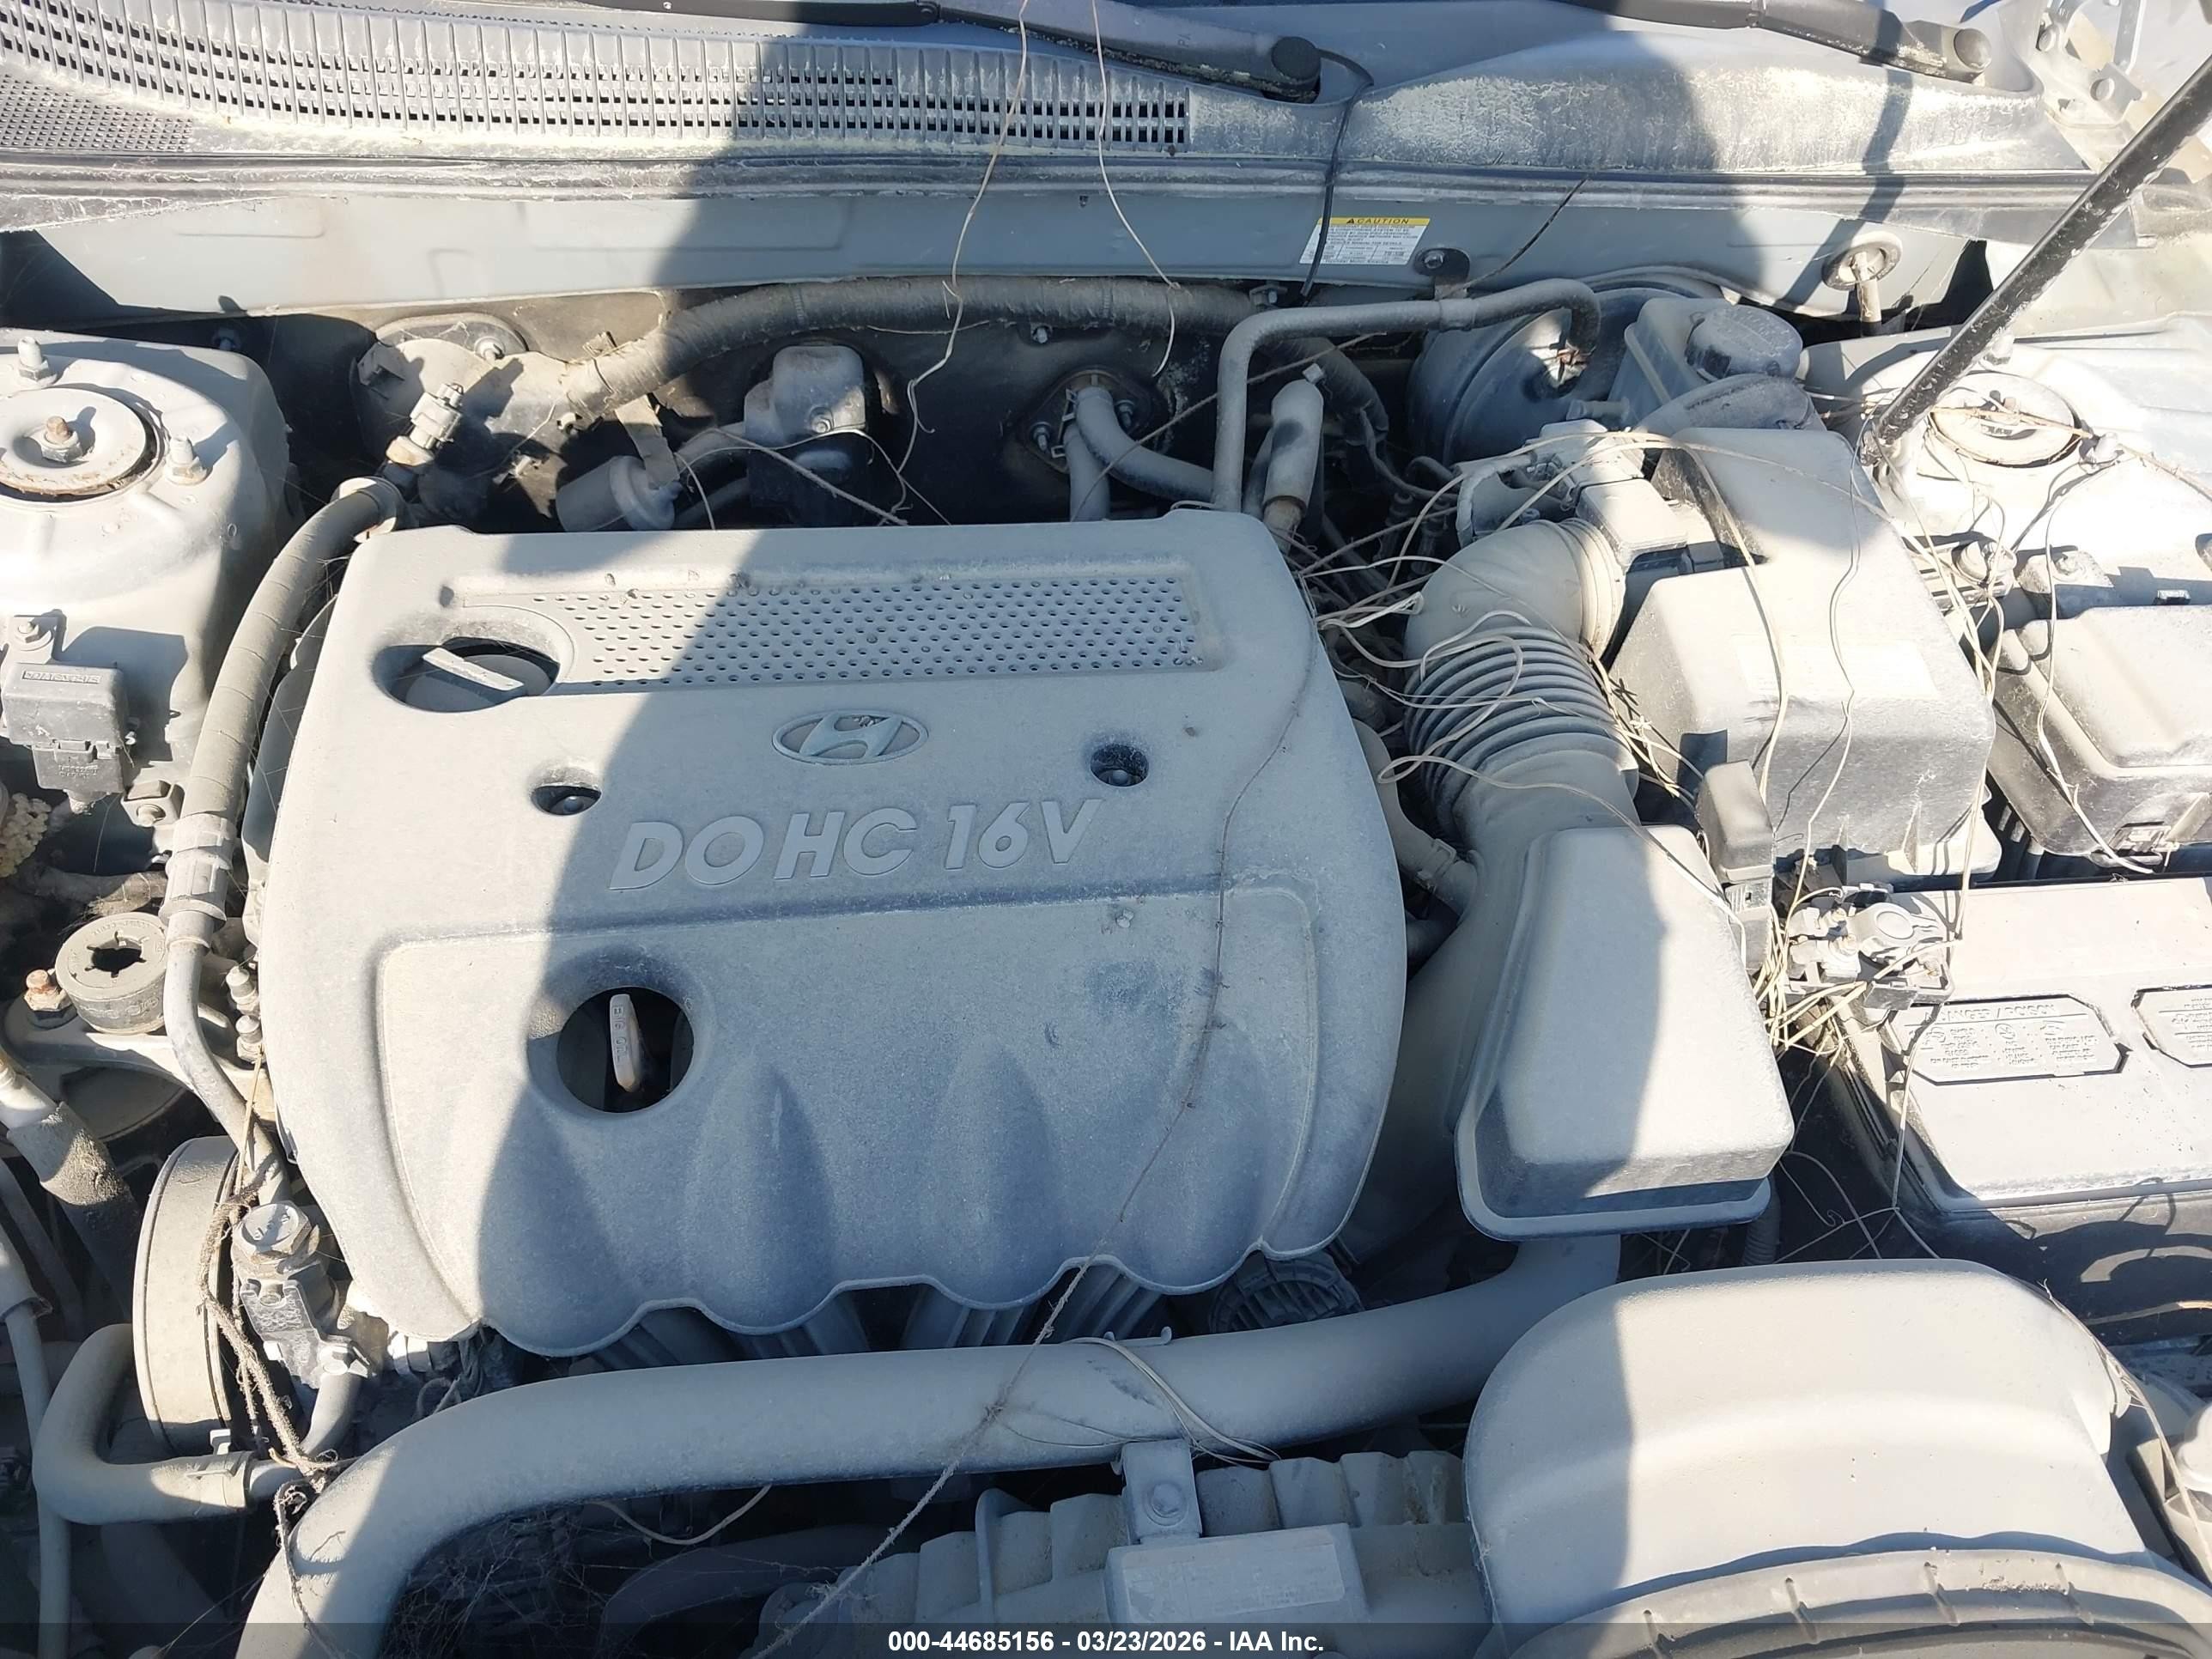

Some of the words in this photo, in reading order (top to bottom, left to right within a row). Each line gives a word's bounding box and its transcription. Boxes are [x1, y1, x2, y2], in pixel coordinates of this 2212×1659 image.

[609, 807, 917, 891] DOHC
[943, 798, 1103, 871] 16V
[2004, 1003, 2055, 1017] POISON
